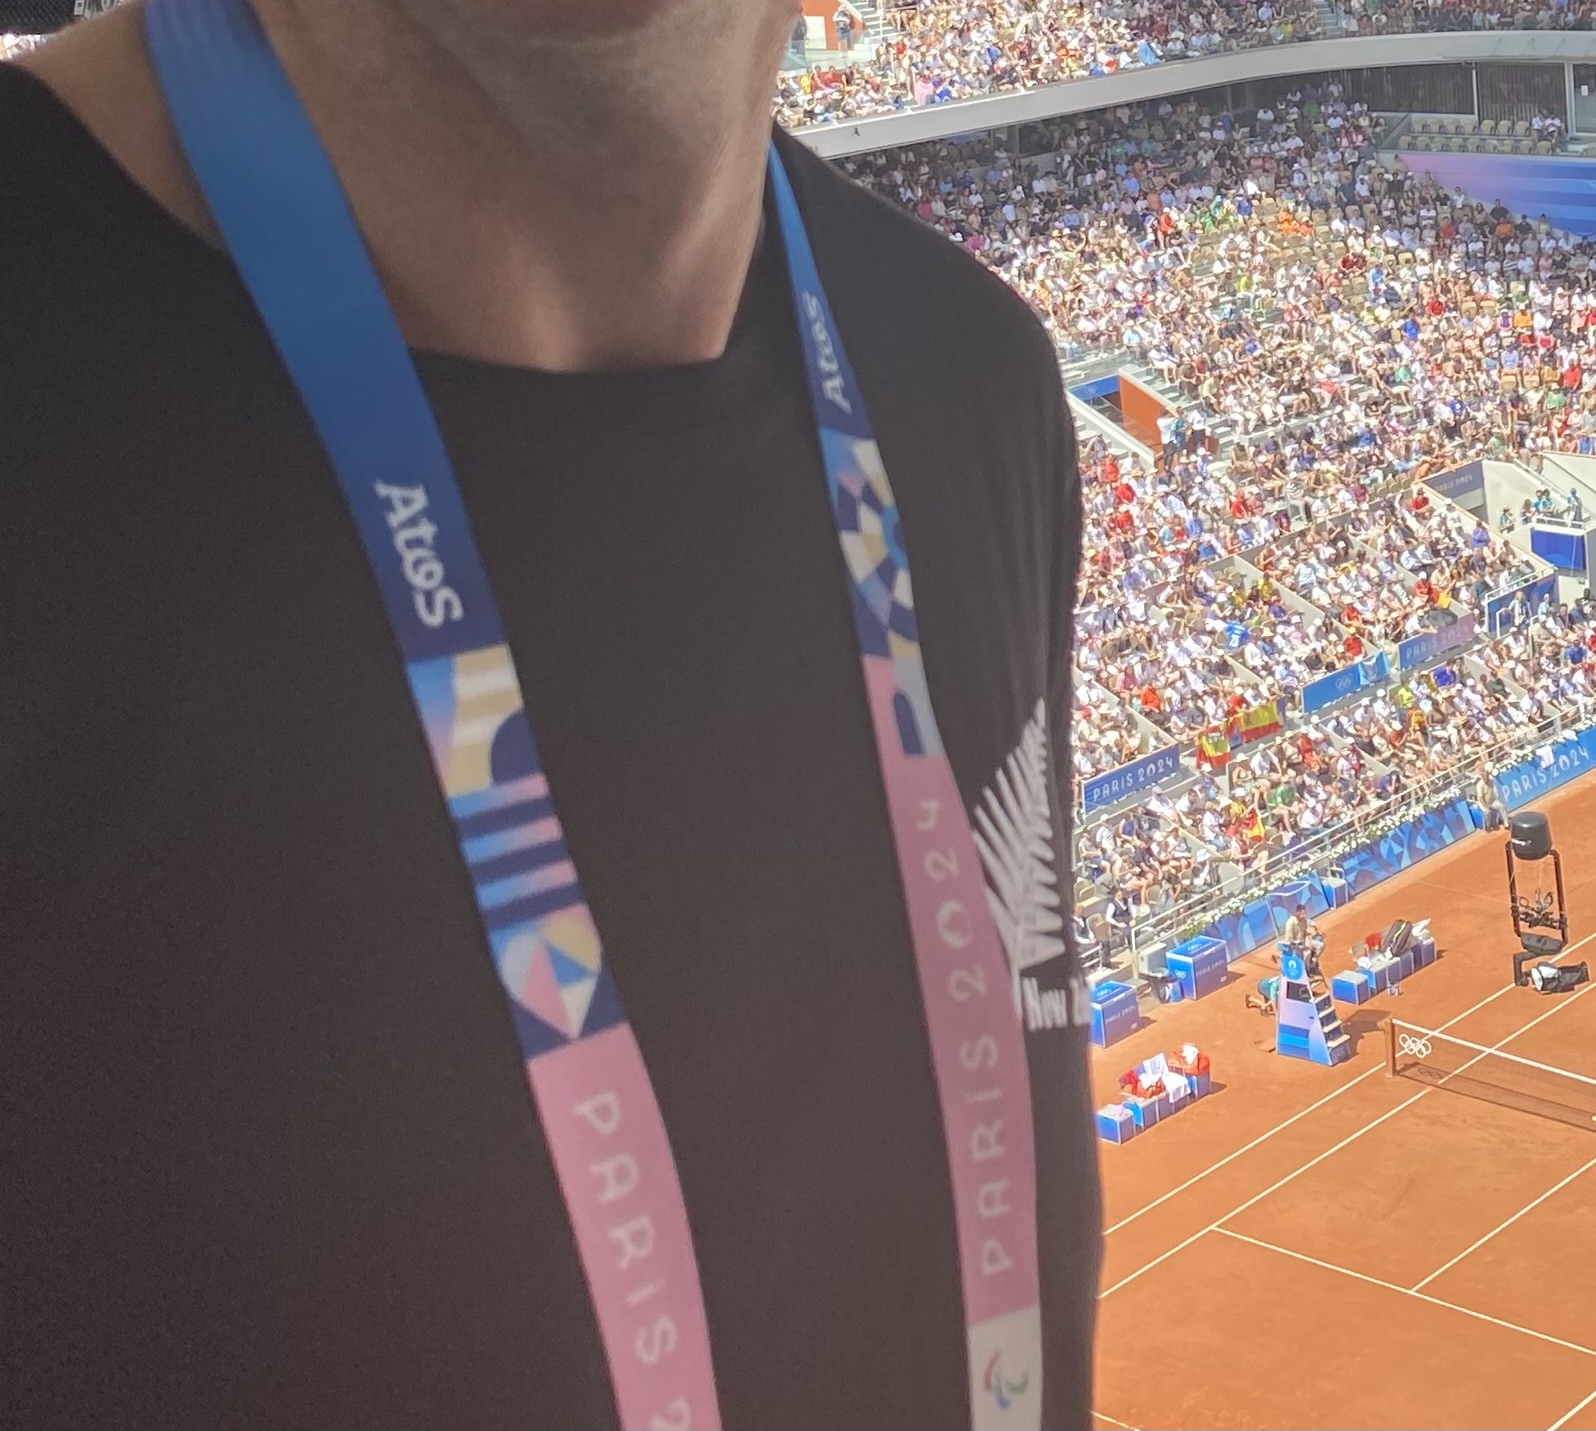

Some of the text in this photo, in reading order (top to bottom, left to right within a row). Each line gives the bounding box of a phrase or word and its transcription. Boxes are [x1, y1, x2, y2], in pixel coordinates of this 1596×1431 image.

[802, 289, 853, 415] Atos
[373, 480, 465, 629] Atos
[1093, 756, 1173, 802] PARIS 2024
[1502, 768, 1547, 801] PARIS
[960, 1034, 1015, 1276] PARIS
[573, 1090, 677, 1365] PARIS
